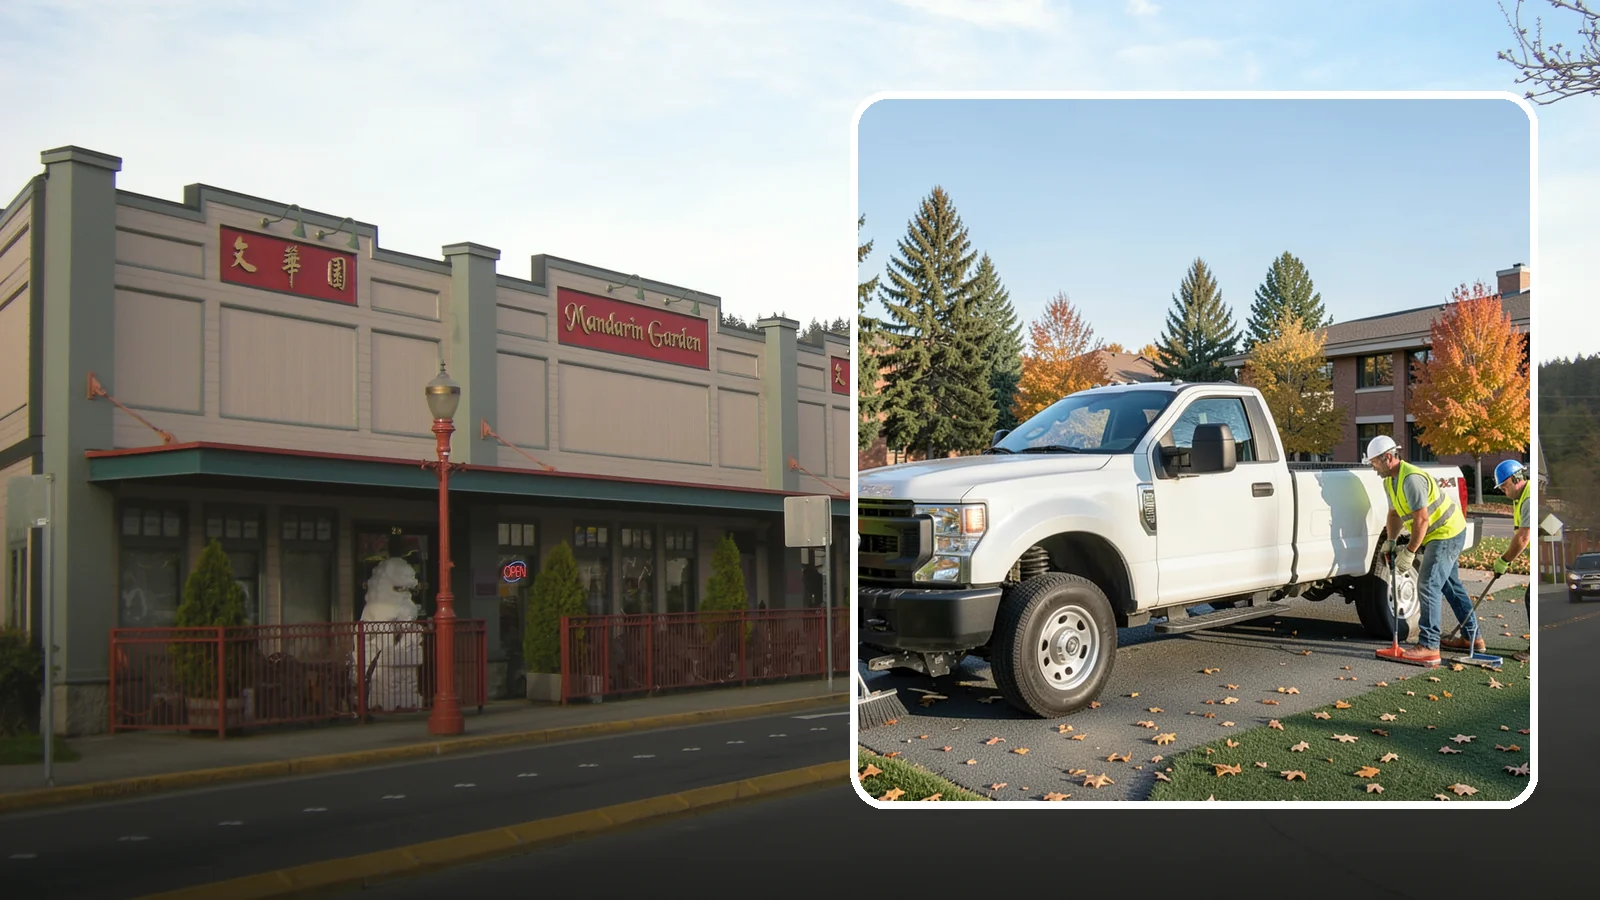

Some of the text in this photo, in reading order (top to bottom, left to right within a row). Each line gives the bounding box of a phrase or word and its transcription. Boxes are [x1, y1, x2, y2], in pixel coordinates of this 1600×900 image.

[231, 235, 346, 291] 文華園
[564, 302, 701, 352] Mandarin Garden
[503, 565, 527, 578] OPEN
